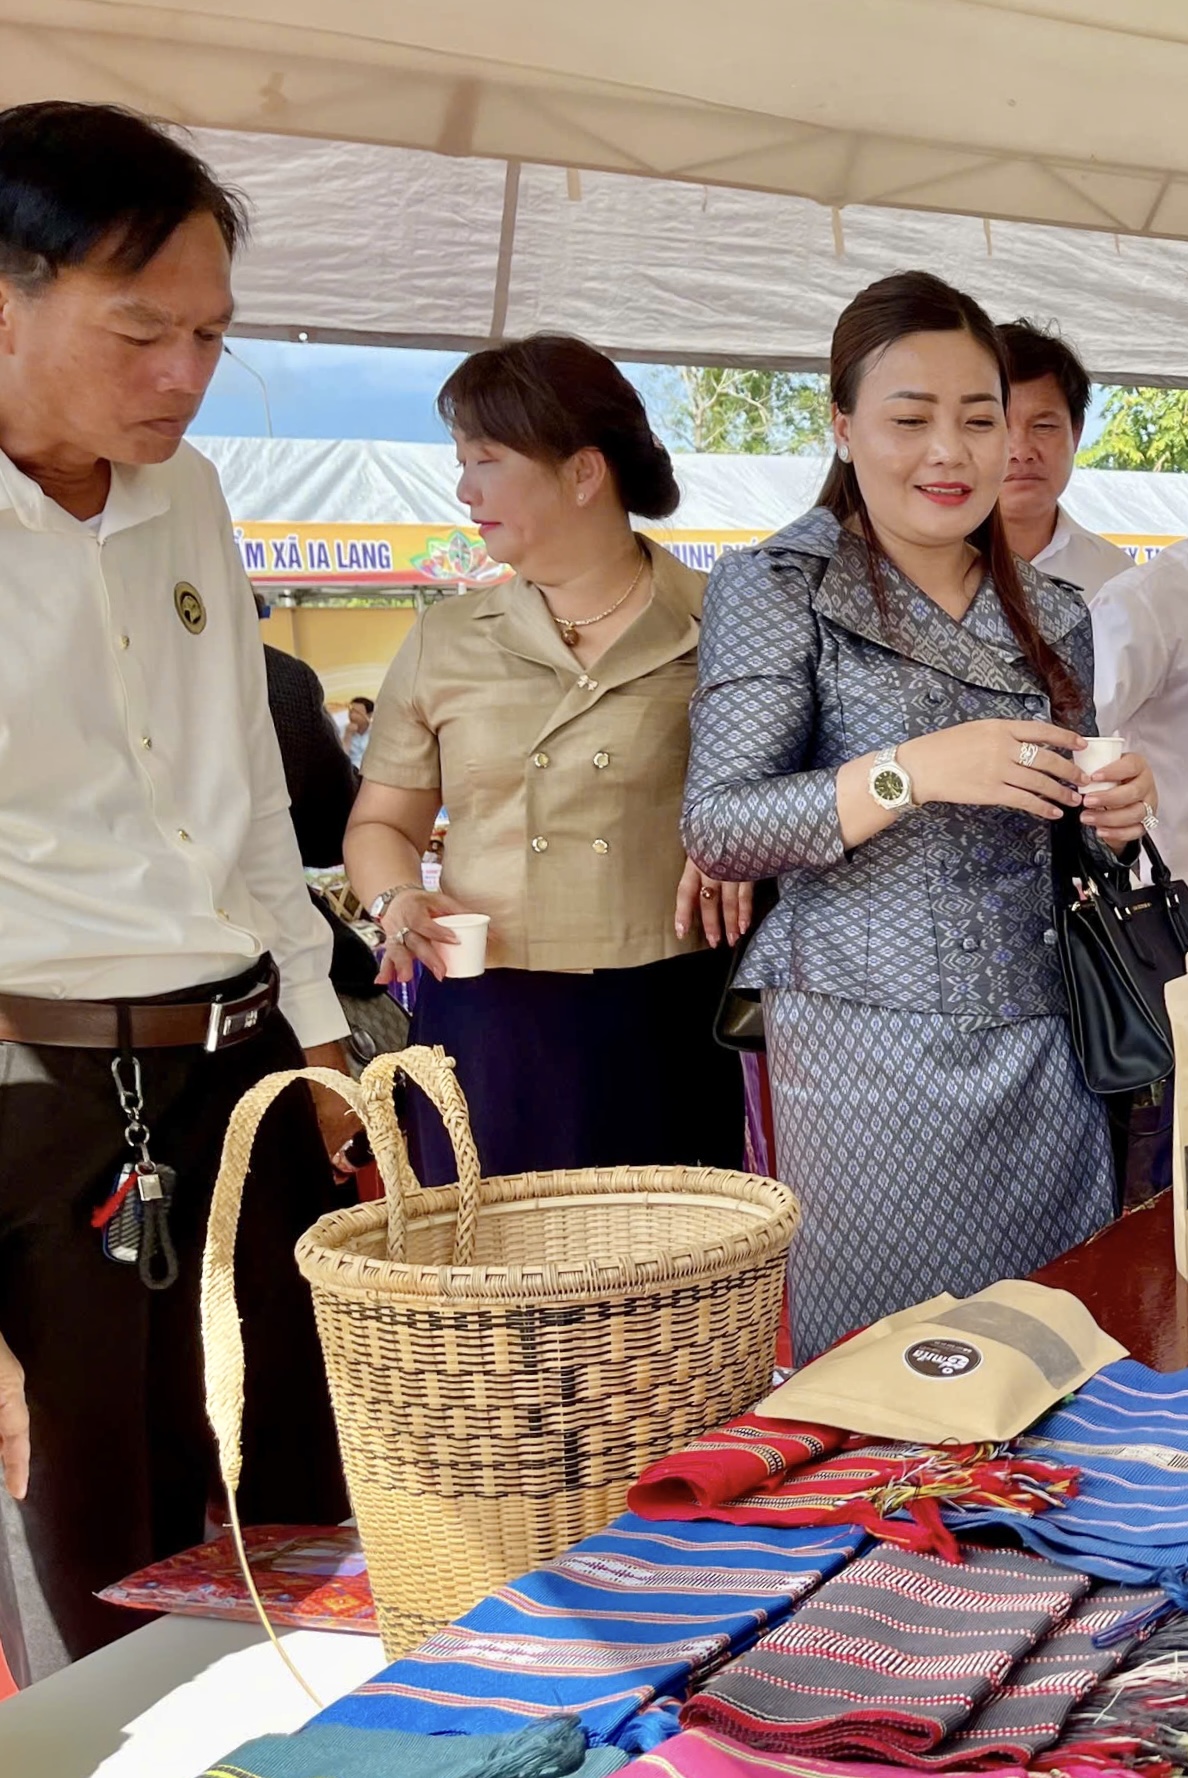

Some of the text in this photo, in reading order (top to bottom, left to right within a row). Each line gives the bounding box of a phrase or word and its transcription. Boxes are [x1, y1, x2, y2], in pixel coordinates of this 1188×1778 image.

[272, 536, 302, 568] XÃ
[308, 541, 330, 568] IA
[336, 541, 391, 568] LANG
